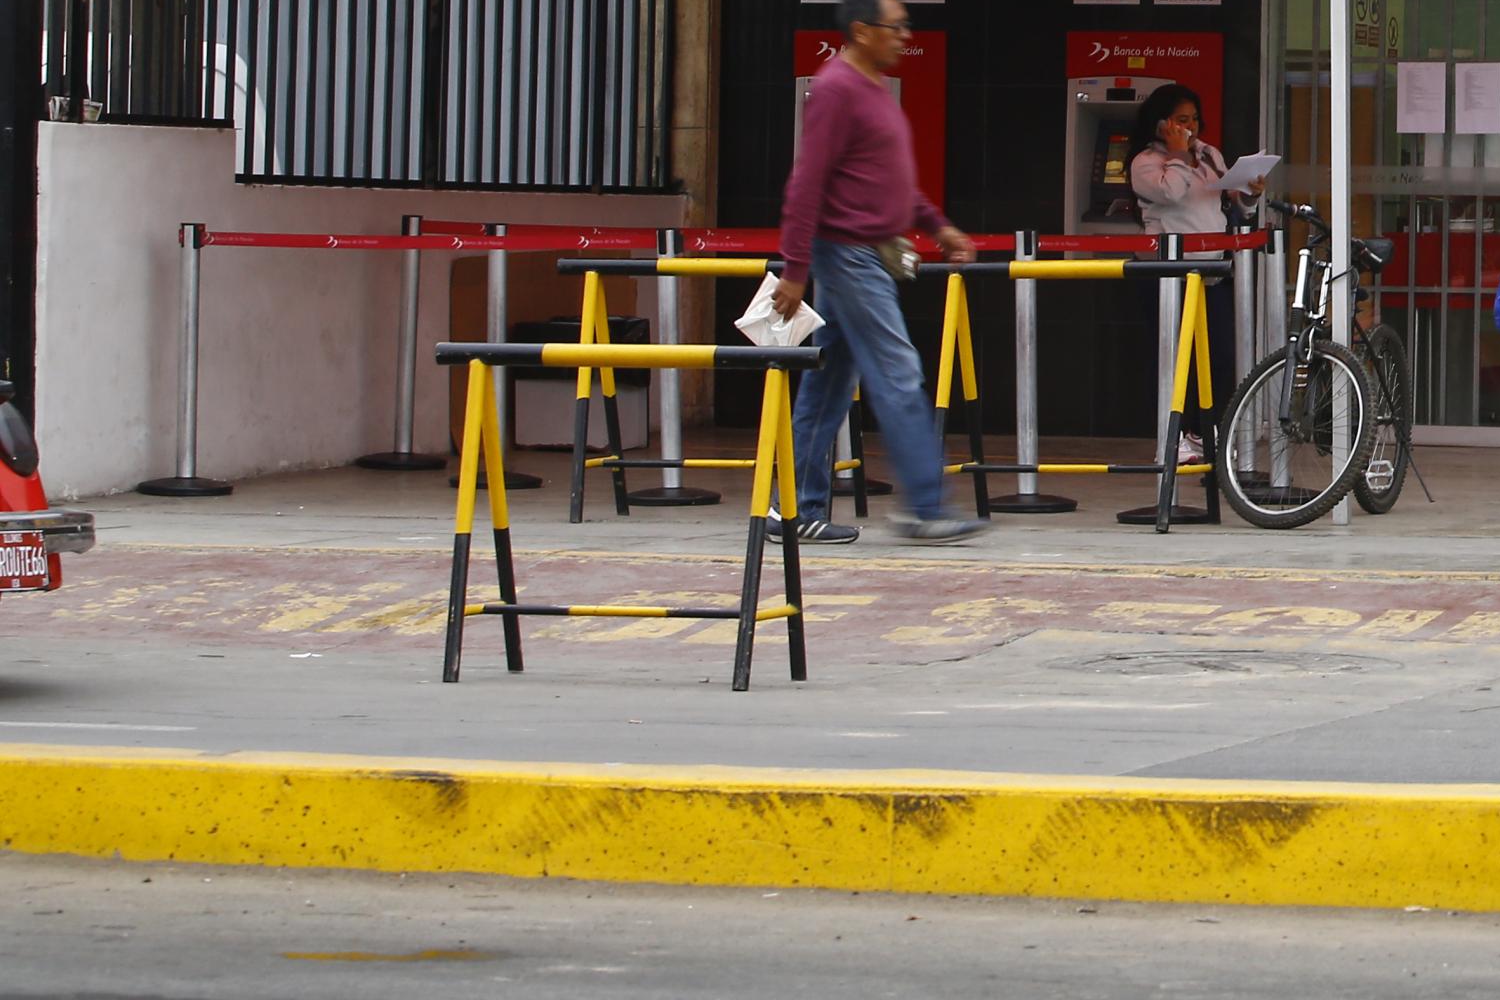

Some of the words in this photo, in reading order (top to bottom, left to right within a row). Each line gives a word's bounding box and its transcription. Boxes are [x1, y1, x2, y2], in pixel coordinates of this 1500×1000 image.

[1114, 46, 1140, 56] Banco
[1143, 46, 1154, 56] de
[1156, 46, 1165, 56] la
[1167, 46, 1200, 56] Nación
